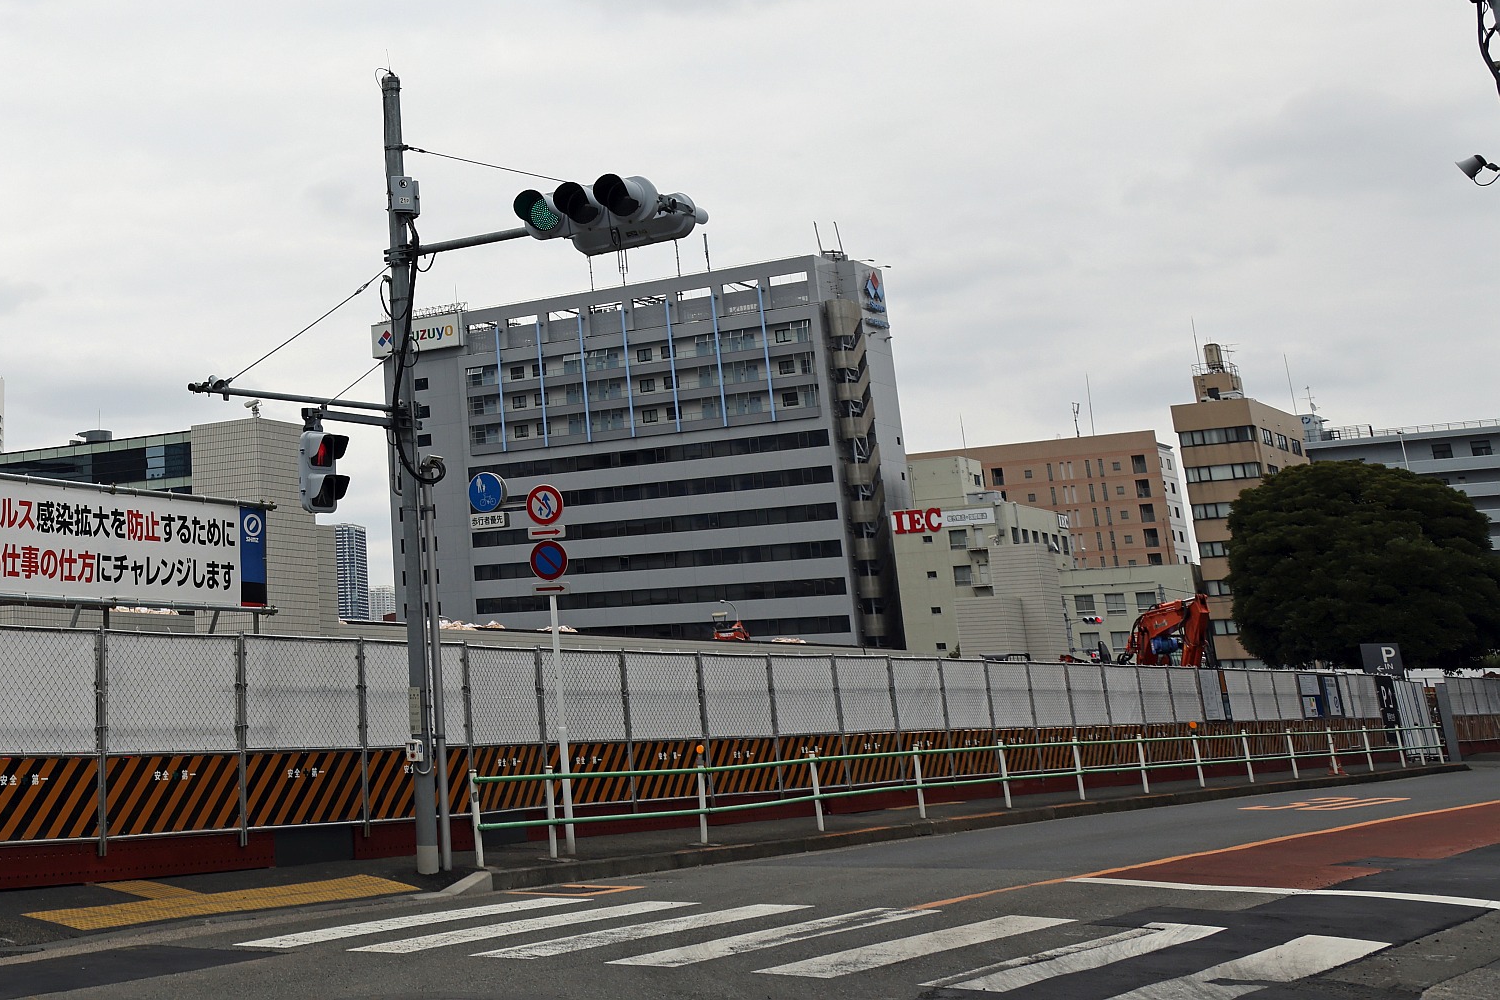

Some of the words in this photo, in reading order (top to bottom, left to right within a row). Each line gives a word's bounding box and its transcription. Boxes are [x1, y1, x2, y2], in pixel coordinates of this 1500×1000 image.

[412, 325, 453, 341] uzuyo
[472, 515, 504, 527] 歩行者優先
[892, 507, 943, 535] IEC
[1381, 646, 1396, 663] P
